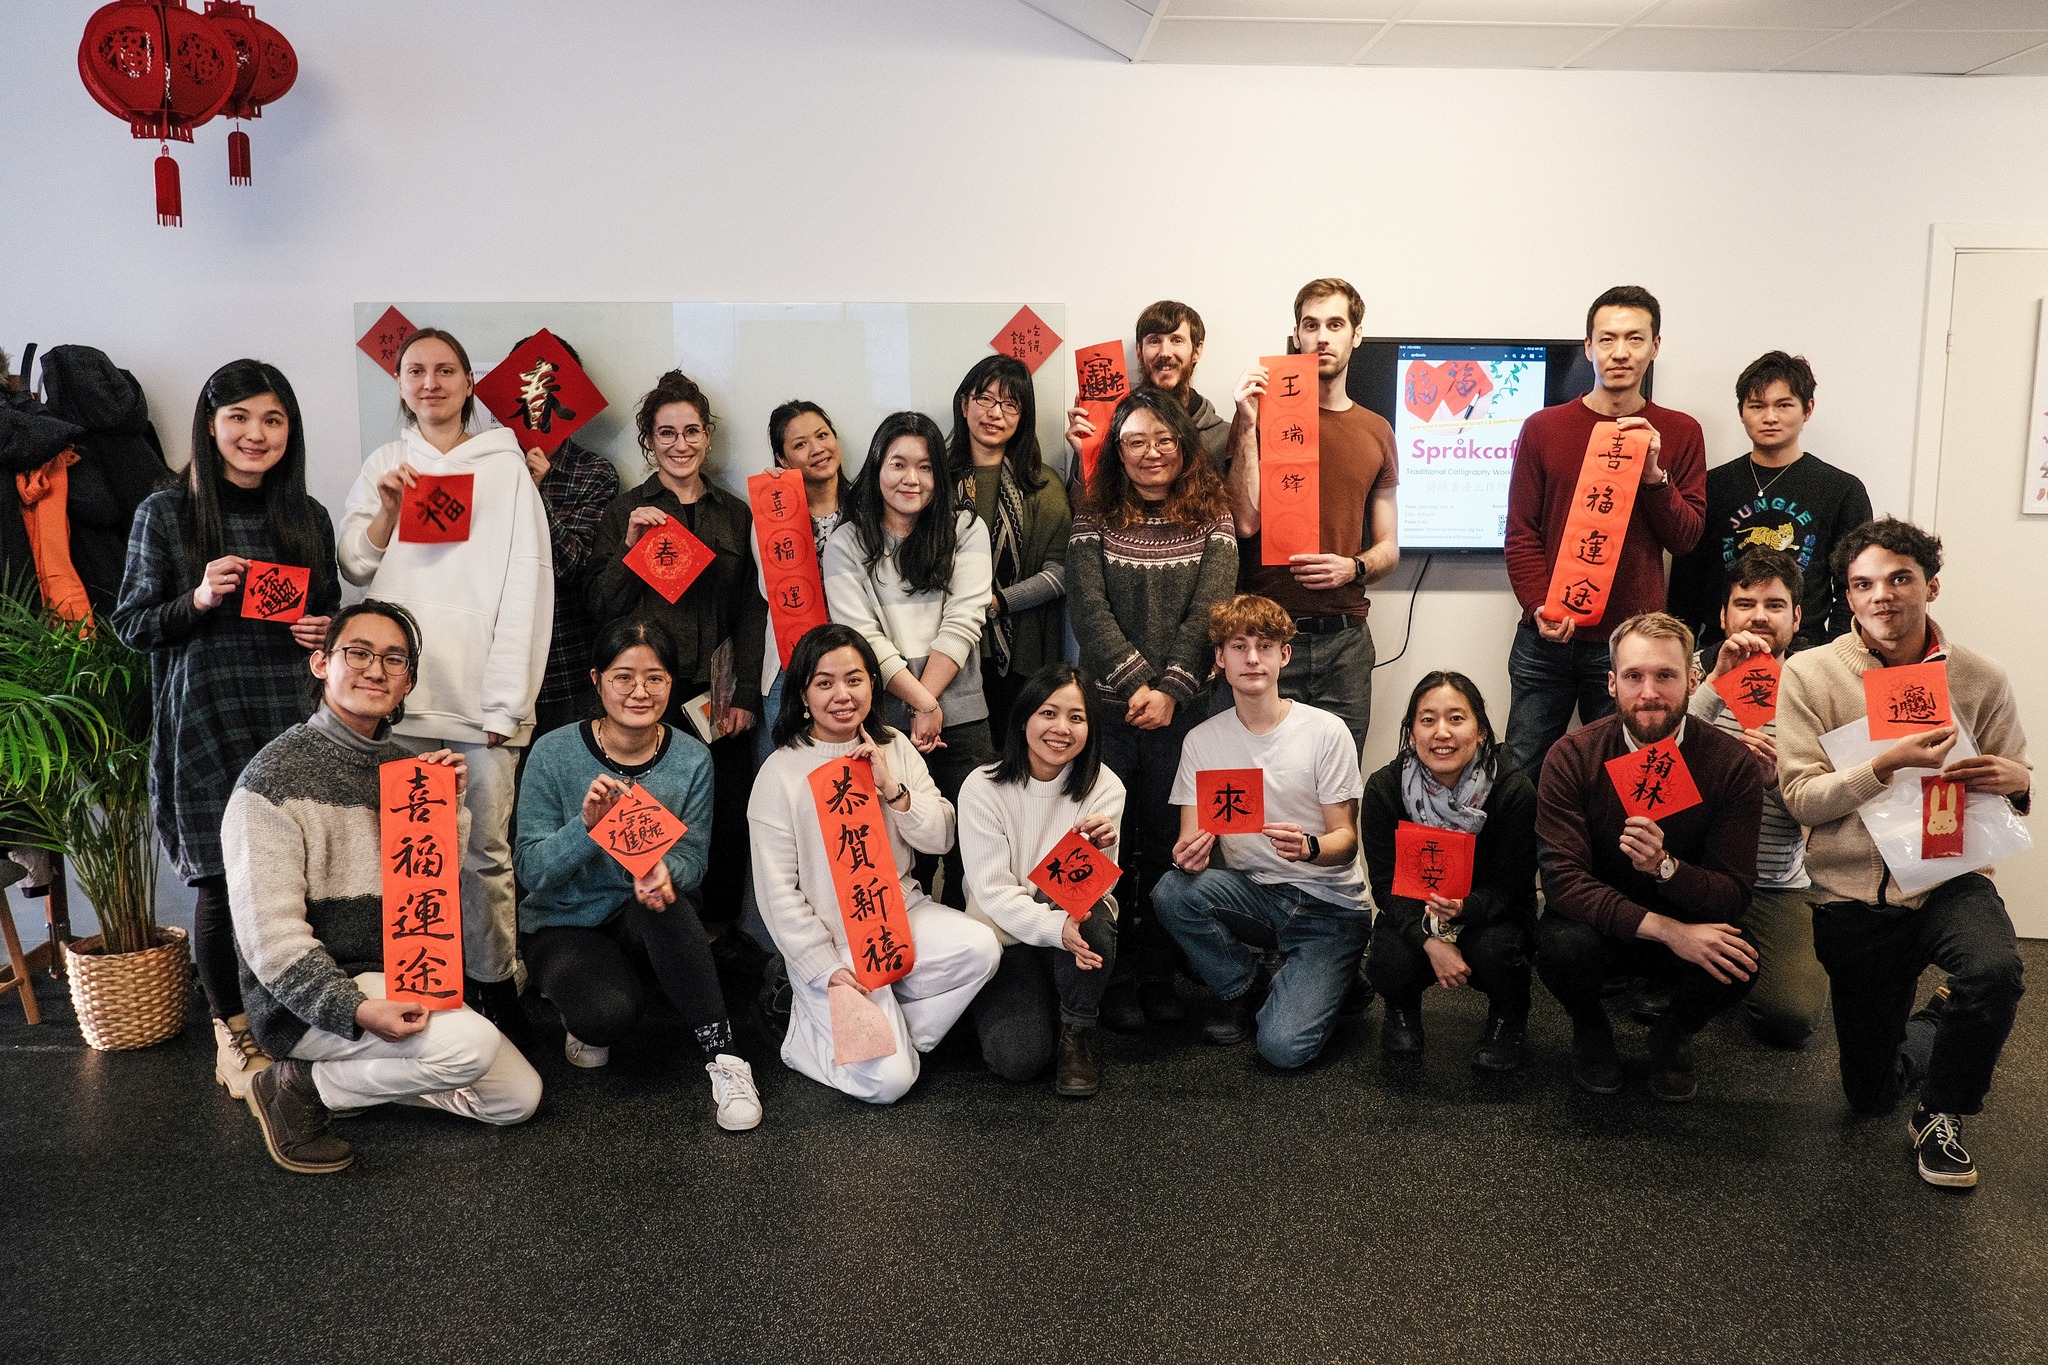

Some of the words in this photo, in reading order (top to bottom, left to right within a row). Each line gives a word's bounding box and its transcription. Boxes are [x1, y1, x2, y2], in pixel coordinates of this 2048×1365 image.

[508, 356, 577, 434] 春
[1279, 374, 1306, 494] 王瑞鋒
[1411, 438, 1518, 465] Språkcaf
[1448, 468, 1491, 476] Calligraphy
[415, 486, 466, 531] 福
[1561, 433, 1633, 615] 喜福運途
[1729, 497, 1813, 529] JUNGLE
[653, 538, 678, 567] 春
[770, 490, 807, 650] 喜福運
[1796, 534, 1816, 573] RIS
[1737, 668, 1776, 707] 愛
[1629, 746, 1676, 811] 翰林
[1213, 783, 1252, 823] 來
[390, 766, 459, 999] 喜福運途
[826, 765, 909, 973] 恭賀新禧
[1046, 847, 1094, 885] 福
[1421, 840, 1445, 891] 平安
